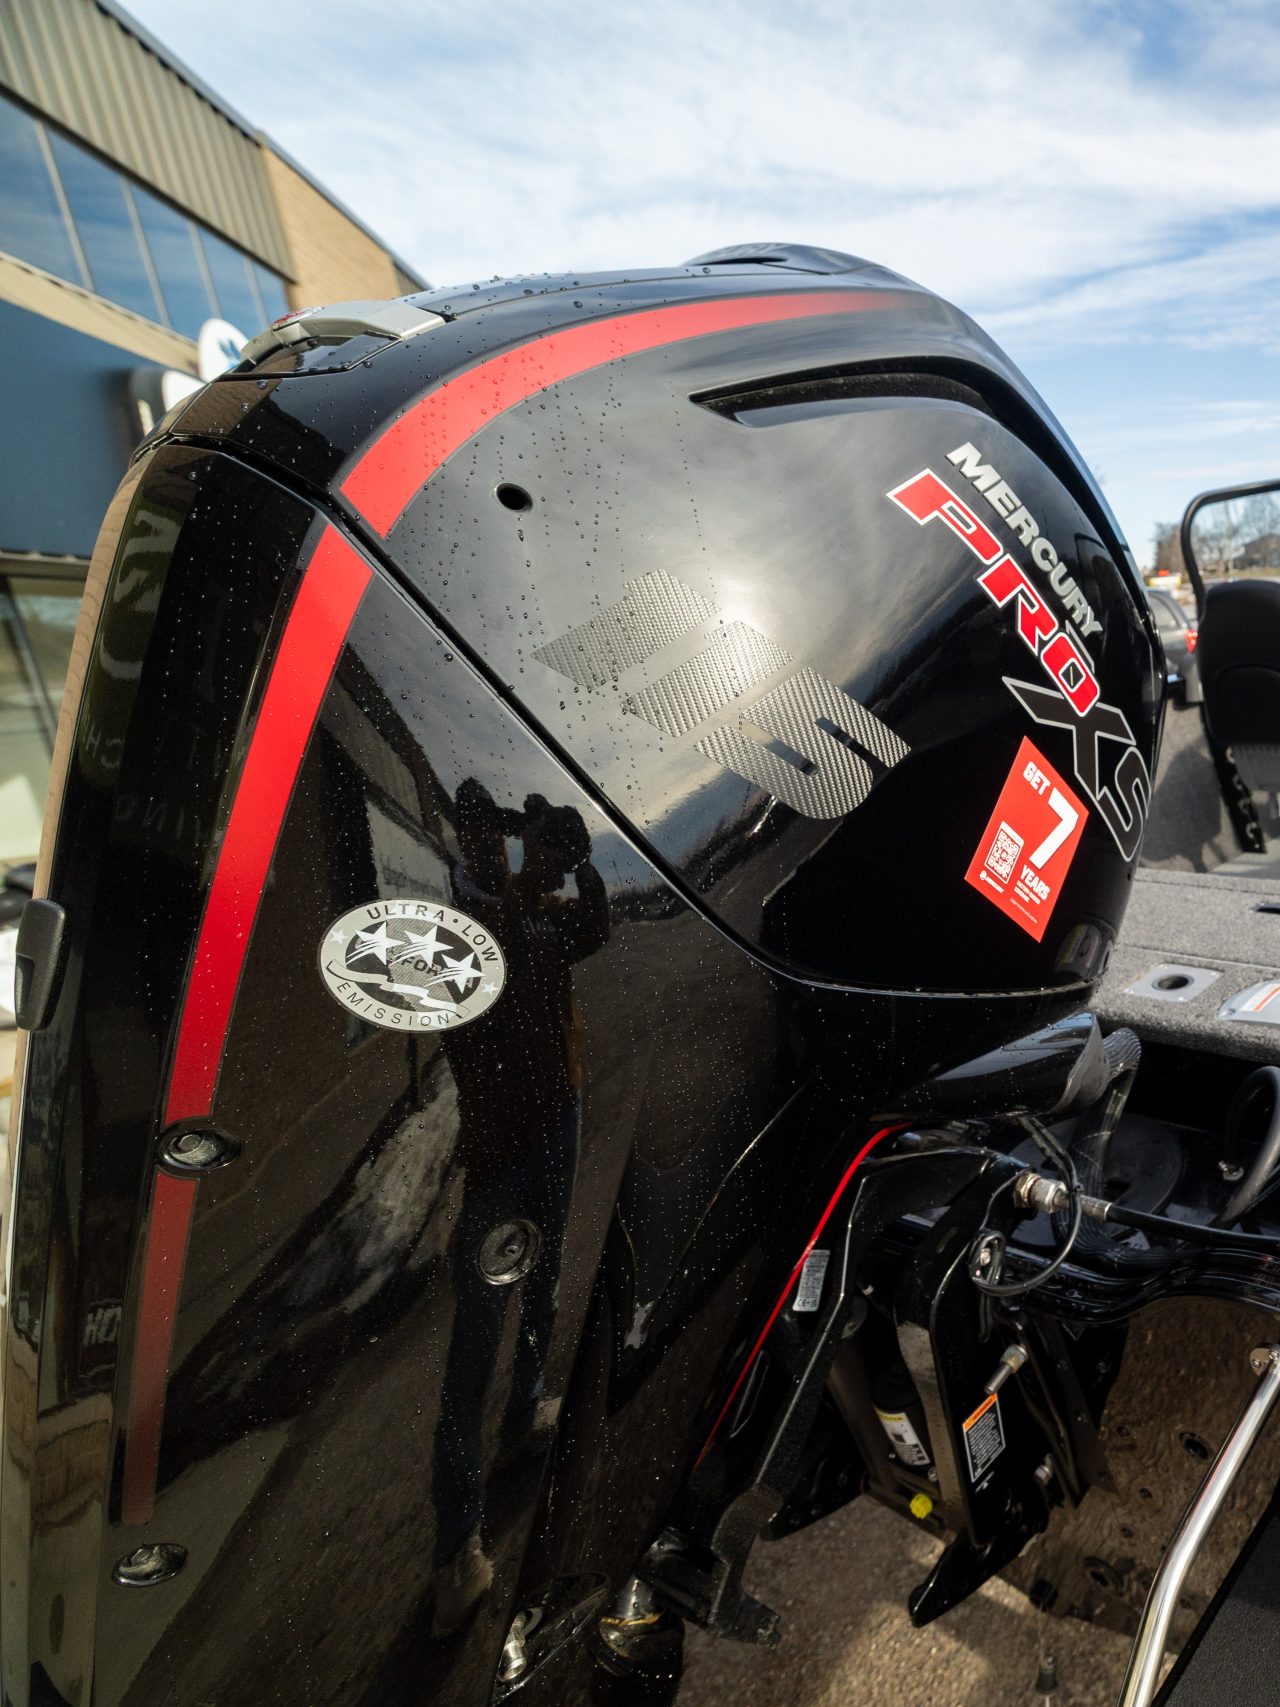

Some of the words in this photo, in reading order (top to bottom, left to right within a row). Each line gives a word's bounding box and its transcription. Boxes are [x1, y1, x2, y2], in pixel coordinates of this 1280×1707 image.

[945, 441, 1102, 637] MERCURY
[885, 468, 1100, 716] PRO
[1002, 622, 1152, 862] XS
[1023, 761, 1051, 795] GET
[1029, 787, 1079, 870] 7
[1020, 864, 1051, 901] YEARS
[366, 903, 446, 923] ULTRA
[461, 924, 499, 962] LOW
[336, 982, 450, 1027] EMISSION
